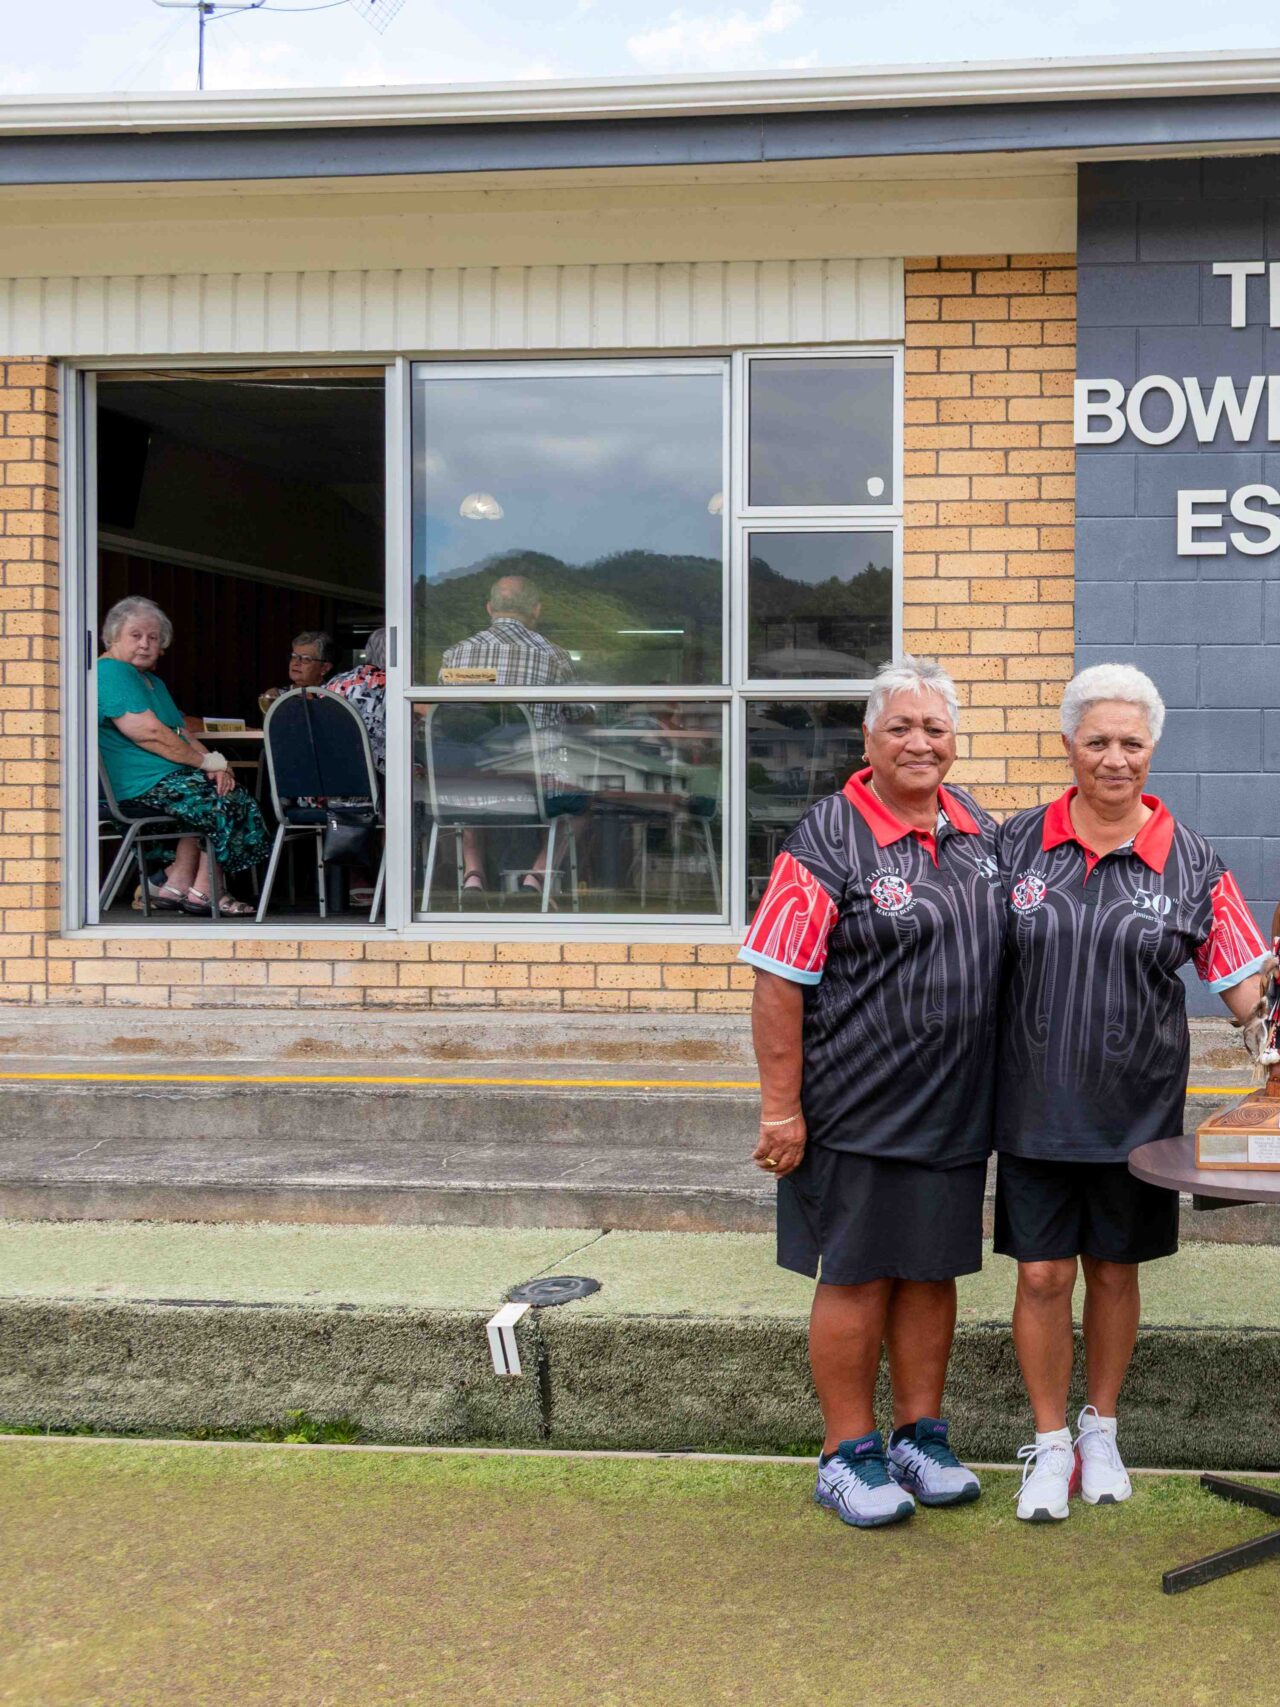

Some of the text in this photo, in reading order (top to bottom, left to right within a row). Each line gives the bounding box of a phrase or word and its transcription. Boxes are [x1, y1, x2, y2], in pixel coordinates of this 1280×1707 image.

[865, 866, 900, 883] TAINUI
[1017, 868, 1048, 880] TAINUI
[899, 898, 919, 916] BOWLS
[1132, 909, 1167, 927] Anniversary
